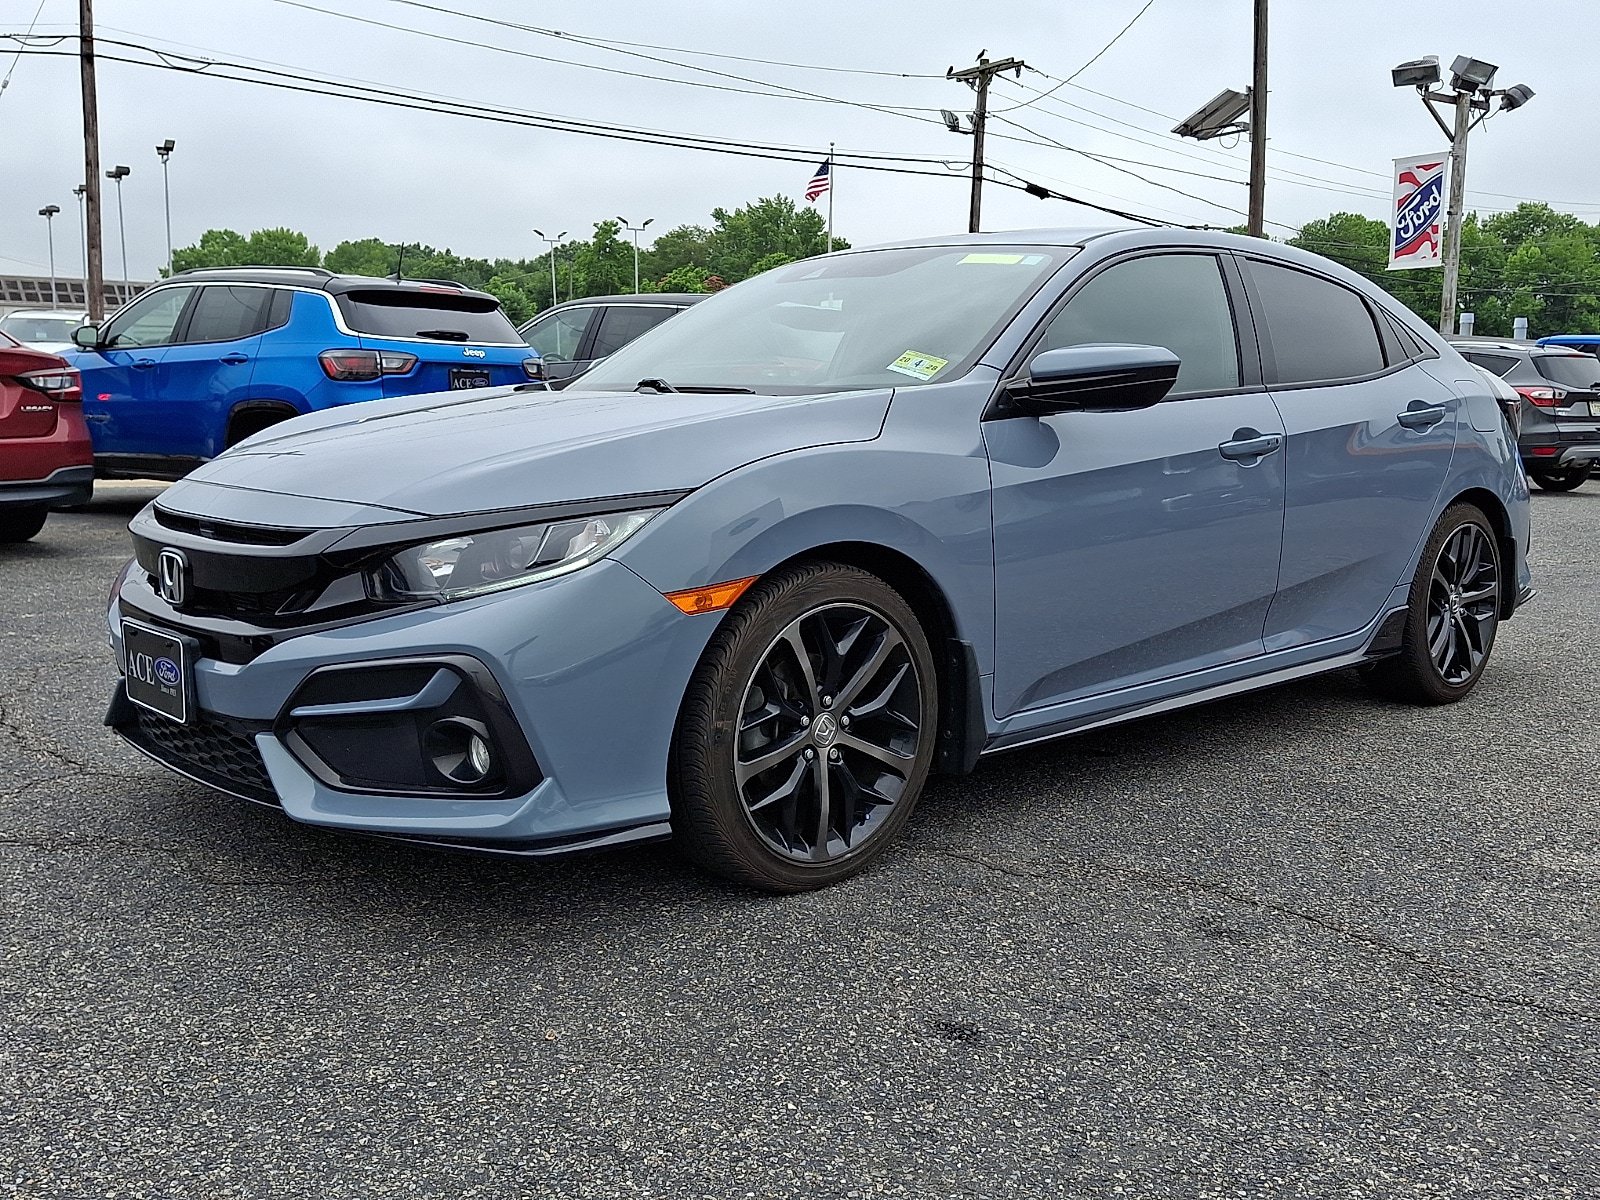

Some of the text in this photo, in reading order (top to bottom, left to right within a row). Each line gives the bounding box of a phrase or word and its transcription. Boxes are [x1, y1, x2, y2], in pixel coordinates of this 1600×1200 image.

[1396, 184, 1440, 239] Ford
[463, 347, 485, 358] Jeep
[914, 359, 924, 368] 4
[453, 378, 473, 389] ACE
[128, 649, 177, 685] ACE Ford
